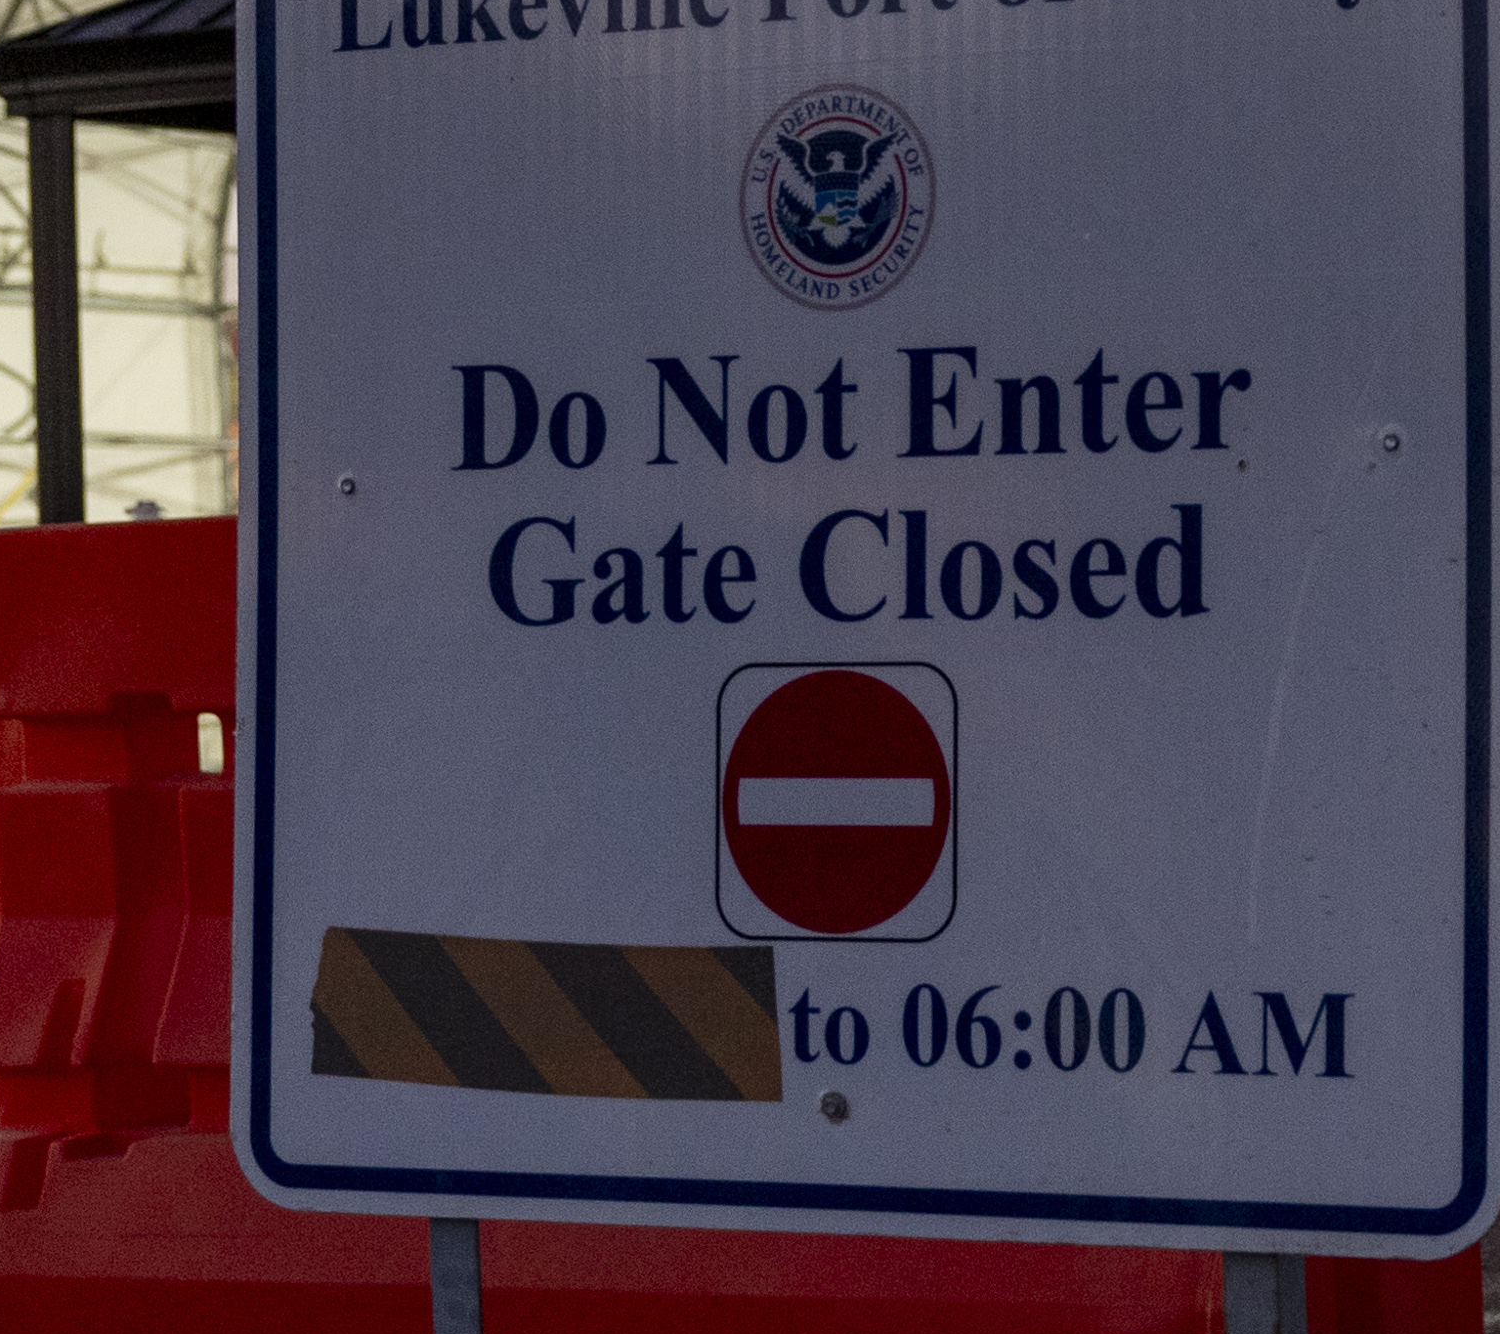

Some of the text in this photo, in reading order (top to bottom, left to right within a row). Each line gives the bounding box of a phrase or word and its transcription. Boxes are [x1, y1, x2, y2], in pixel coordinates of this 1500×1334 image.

[780, 95, 912, 146] DEPARTMENT
[903, 147, 925, 179] OF
[751, 203, 924, 300] HOMELAND SECURITY
[451, 346, 1252, 471] Do Not Enter
[489, 503, 1211, 627] Gate Closed
[789, 983, 1356, 1078] to 06:00 AM
